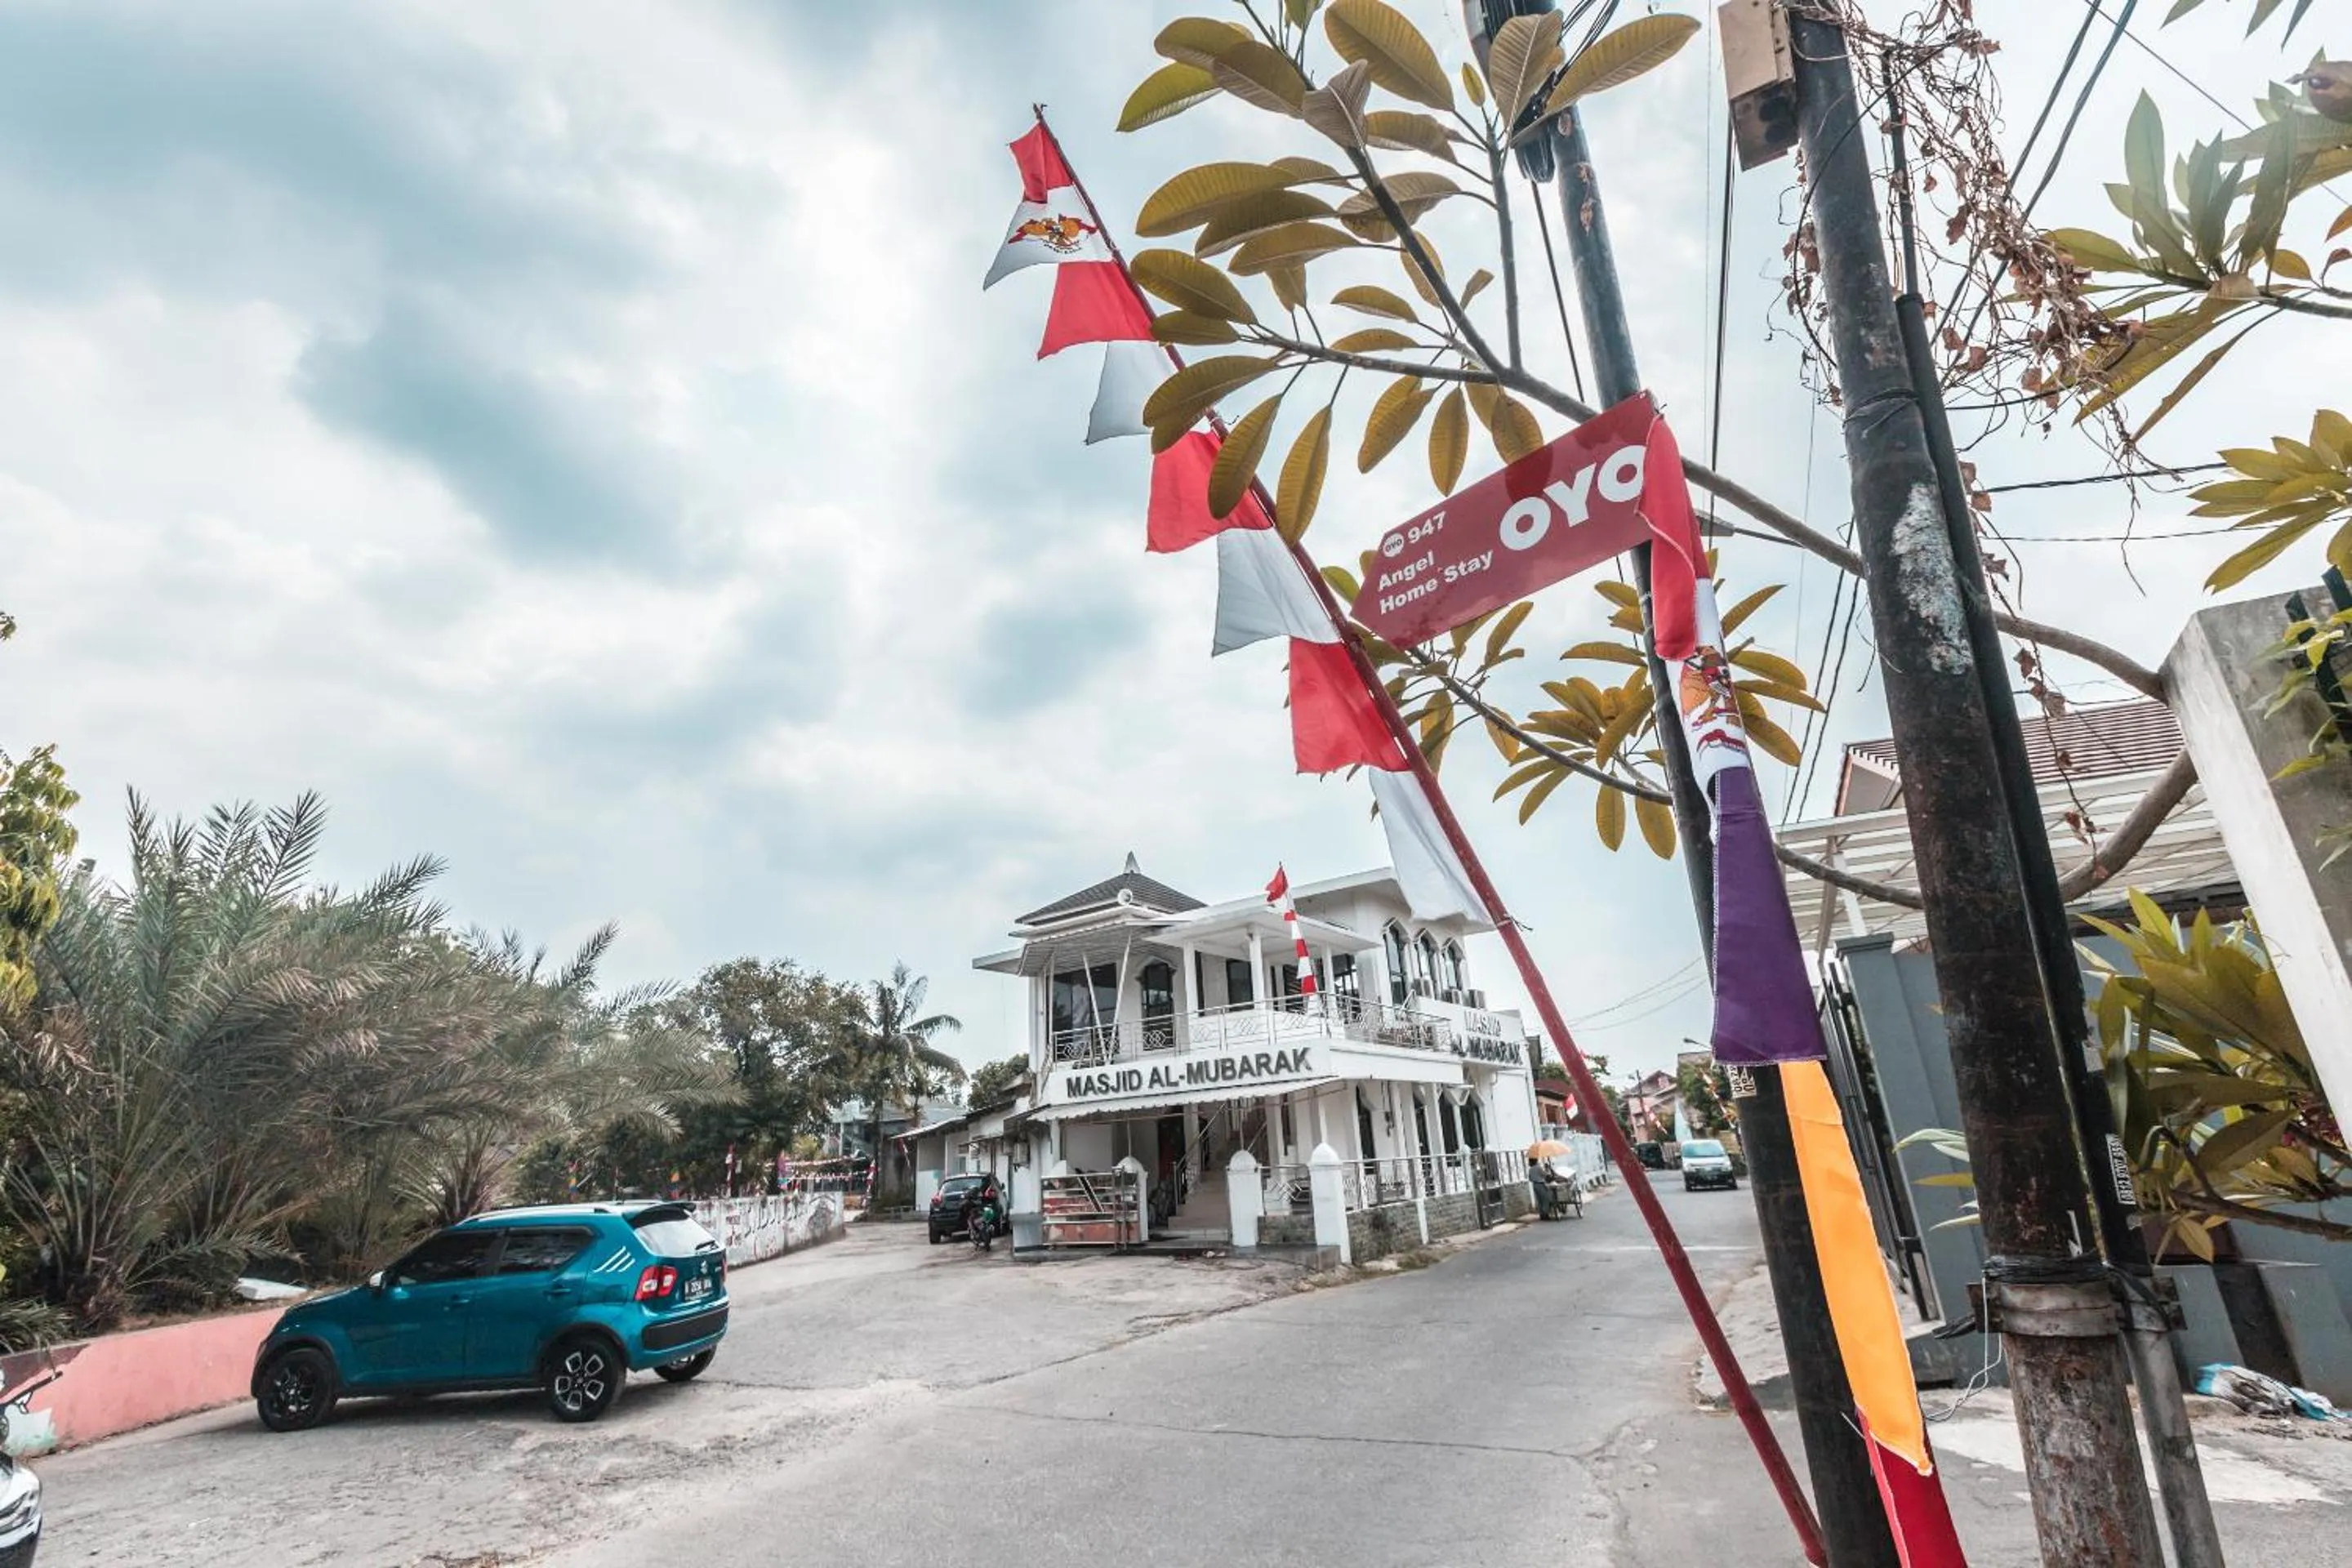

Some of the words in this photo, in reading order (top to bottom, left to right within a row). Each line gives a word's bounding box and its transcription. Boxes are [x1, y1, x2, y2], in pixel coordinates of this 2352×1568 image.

[1499, 444, 1647, 551] OYO
[1407, 510, 1446, 545] 947
[1377, 550, 1435, 591] Angel
[1379, 578, 1438, 615] Home
[1443, 549, 1494, 584] Stay
[1066, 1068, 1142, 1098] MASJID
[1147, 1047, 1312, 1089] AL-MUBARAK
